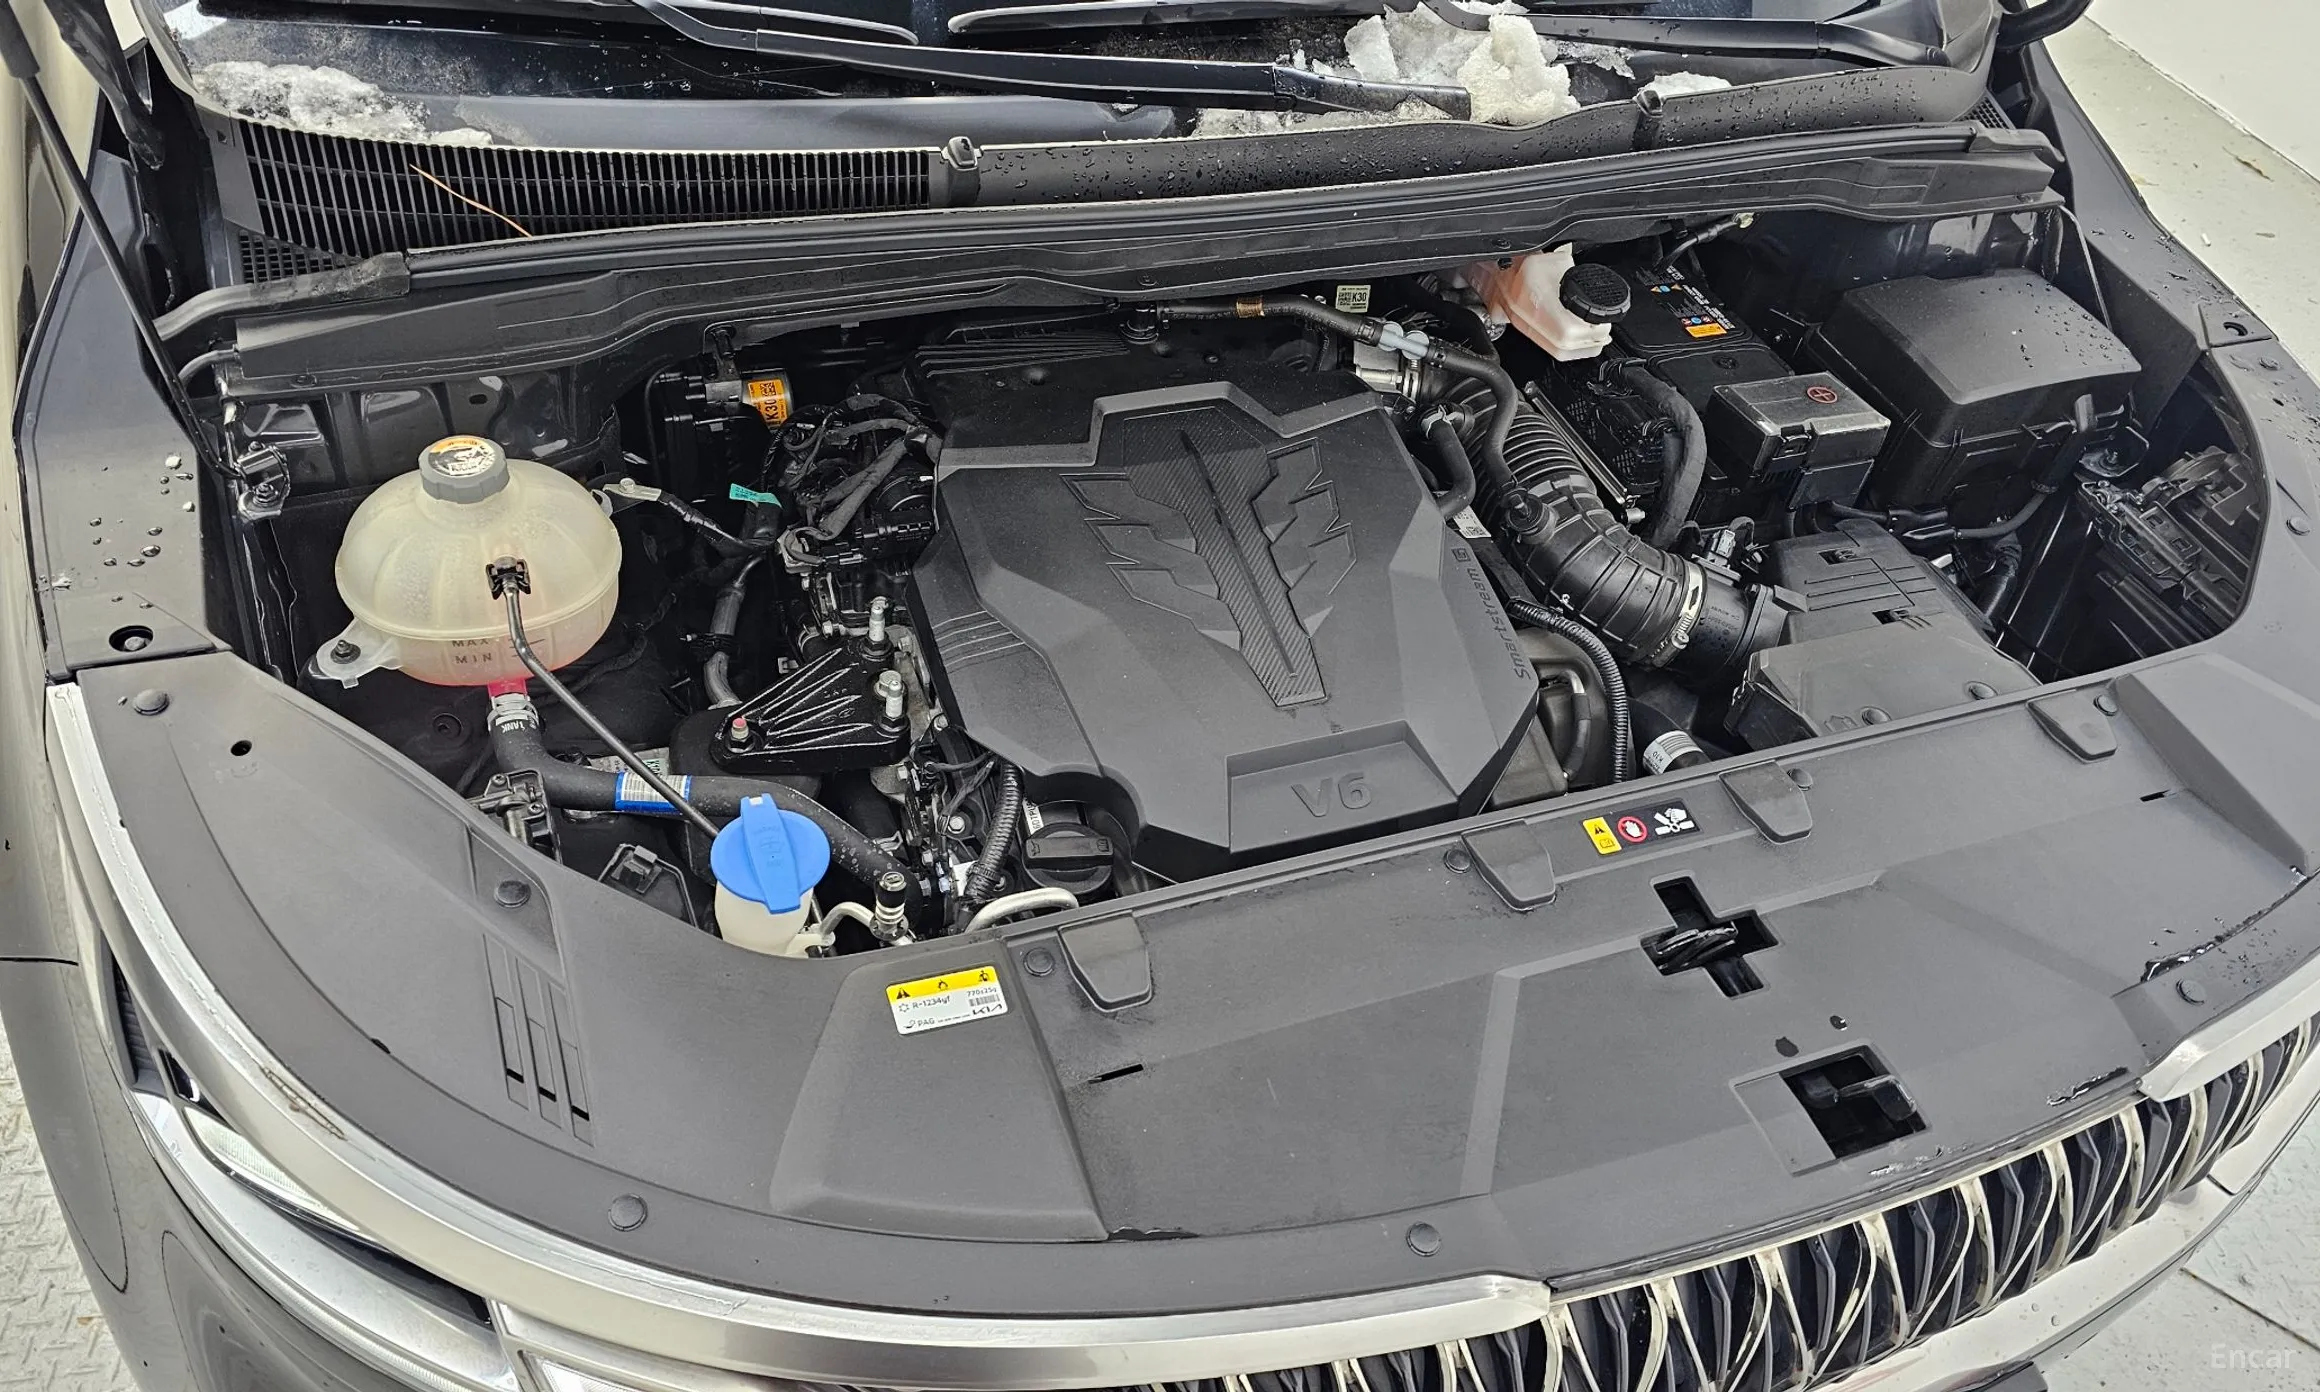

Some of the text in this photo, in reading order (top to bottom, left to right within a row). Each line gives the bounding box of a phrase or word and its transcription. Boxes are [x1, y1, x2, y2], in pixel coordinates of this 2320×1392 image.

[1352, 292, 1367, 302] K30
[764, 399, 779, 420] K30
[1467, 567, 1532, 680] Smartstream
[452, 638, 489, 647] MAX
[455, 652, 492, 664] MIN
[501, 720, 525, 734] TANK
[1291, 772, 1372, 818] V6
[912, 995, 952, 1009] R-1234yf
[973, 1003, 1003, 1015] KIA
[917, 1017, 936, 1028] PAG
